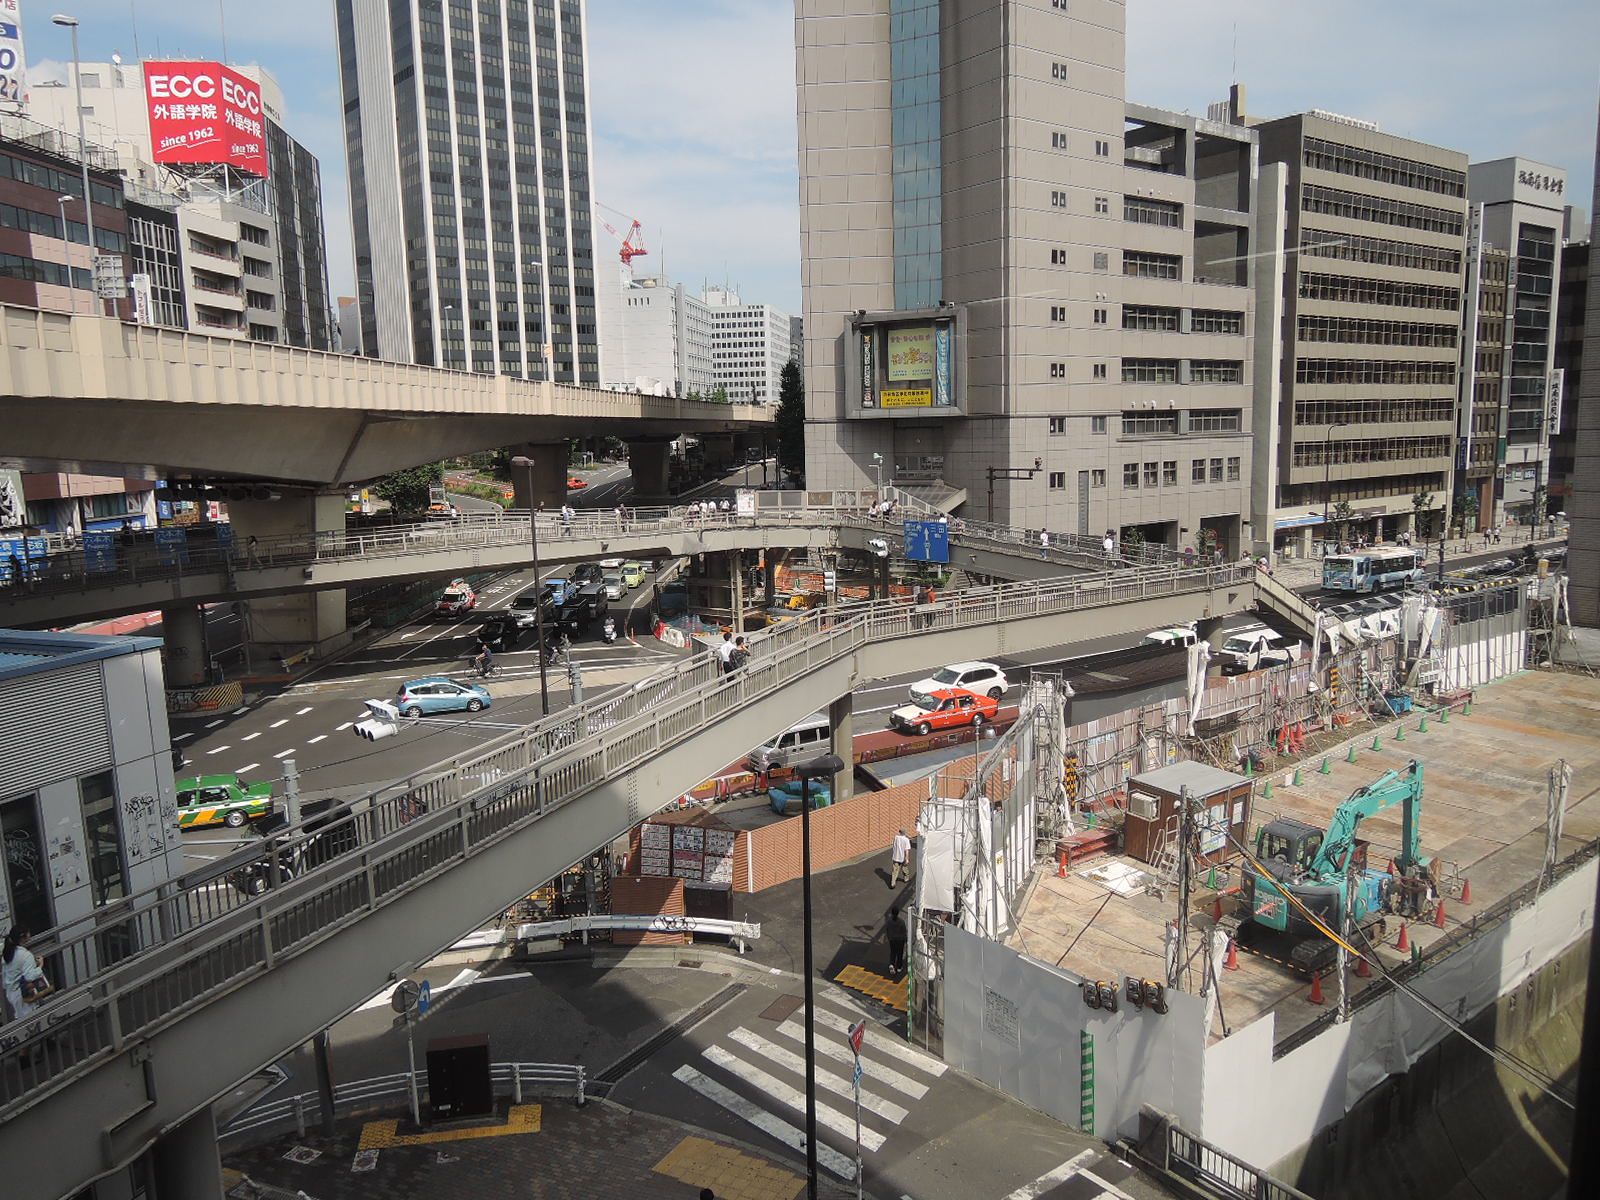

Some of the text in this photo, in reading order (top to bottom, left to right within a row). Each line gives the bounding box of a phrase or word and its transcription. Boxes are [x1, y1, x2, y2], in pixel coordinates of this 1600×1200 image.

[149, 75, 216, 98] ECC
[221, 76, 260, 115] ECC
[153, 103, 218, 120] 外語学院
[225, 108, 262, 139] 外語学院
[160, 127, 215, 149] since 1962
[231, 143, 260, 154] since 1962
